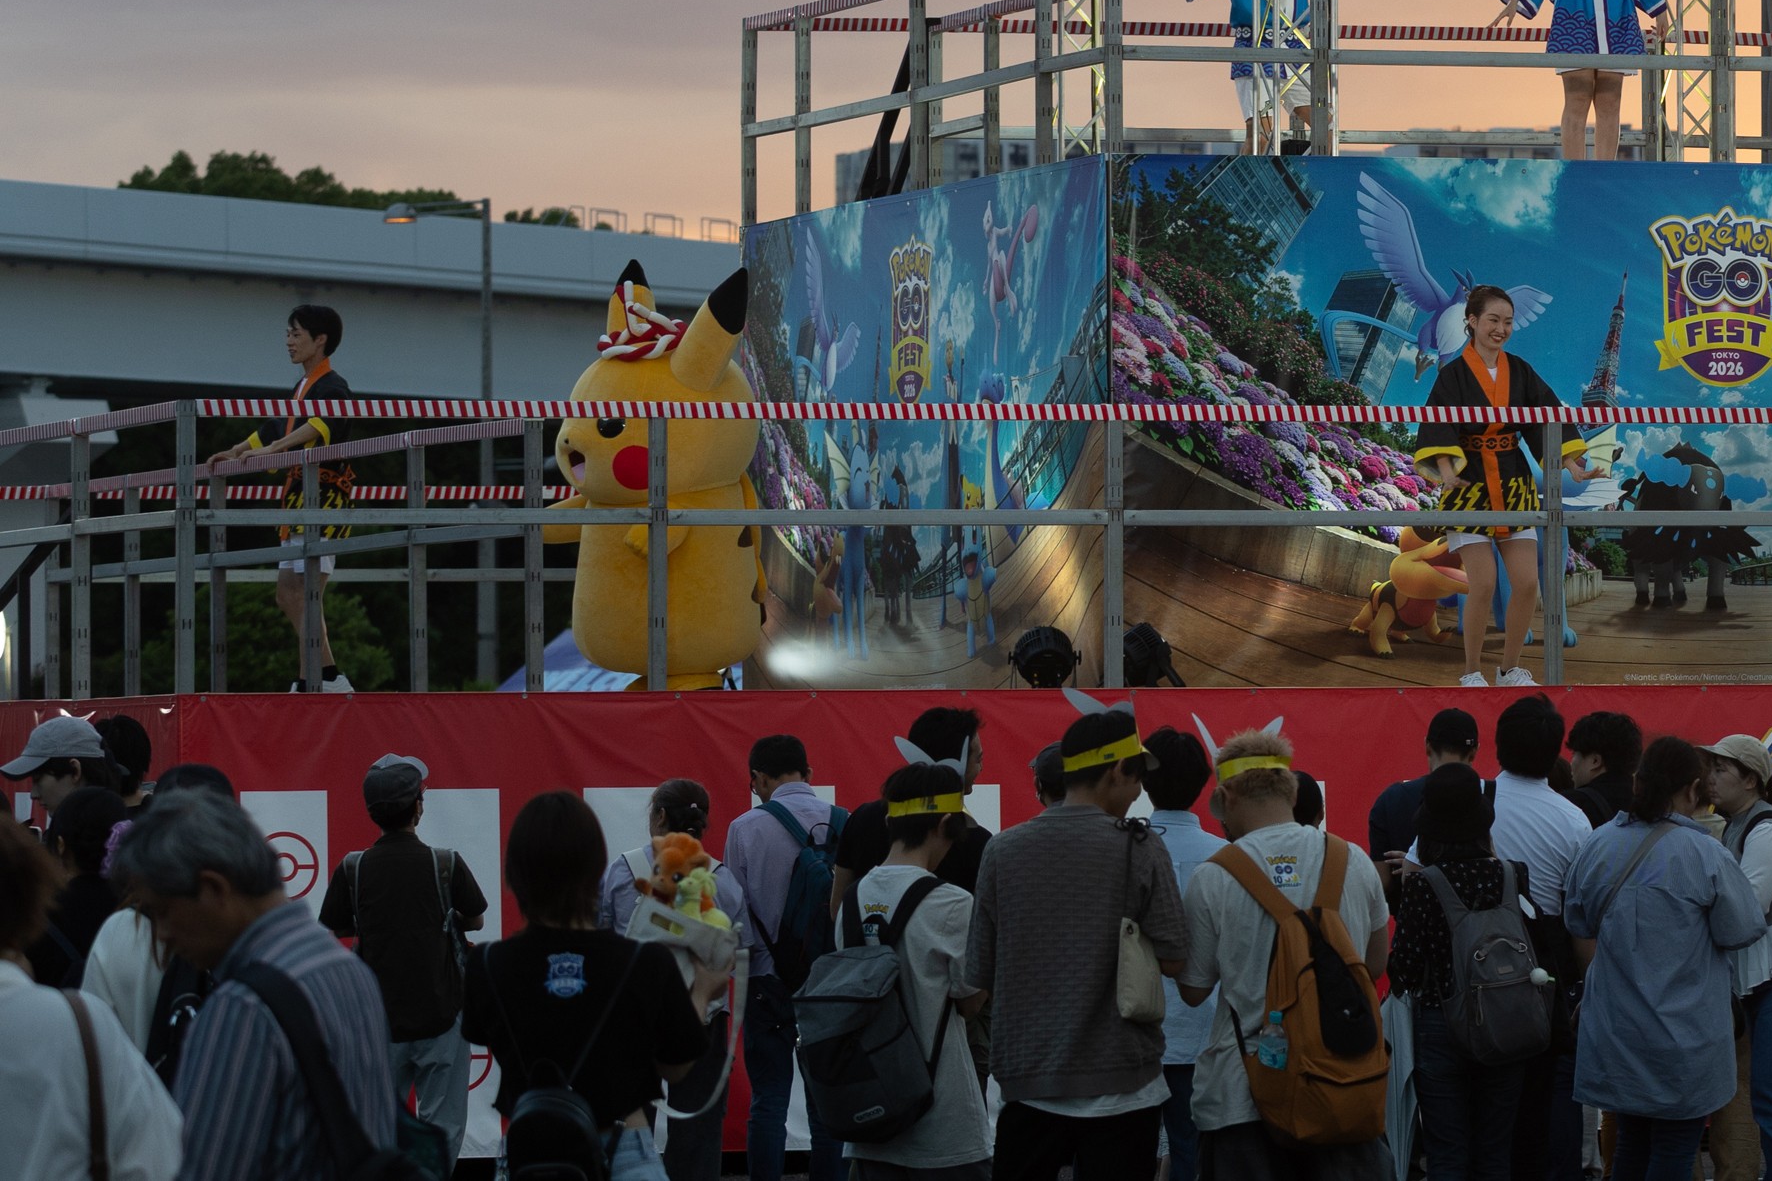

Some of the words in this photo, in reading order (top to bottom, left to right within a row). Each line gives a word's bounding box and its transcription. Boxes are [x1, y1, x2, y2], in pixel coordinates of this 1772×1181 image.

[1686, 257, 1763, 302] GO
[898, 285, 924, 325] GO
[1685, 318, 1767, 348] FEST
[897, 342, 924, 371] FEST
[1711, 351, 1740, 360] TOKYO
[1708, 361, 1744, 376] 2026
[1273, 875, 1283, 884] 10
[1275, 865, 1293, 875] GO
